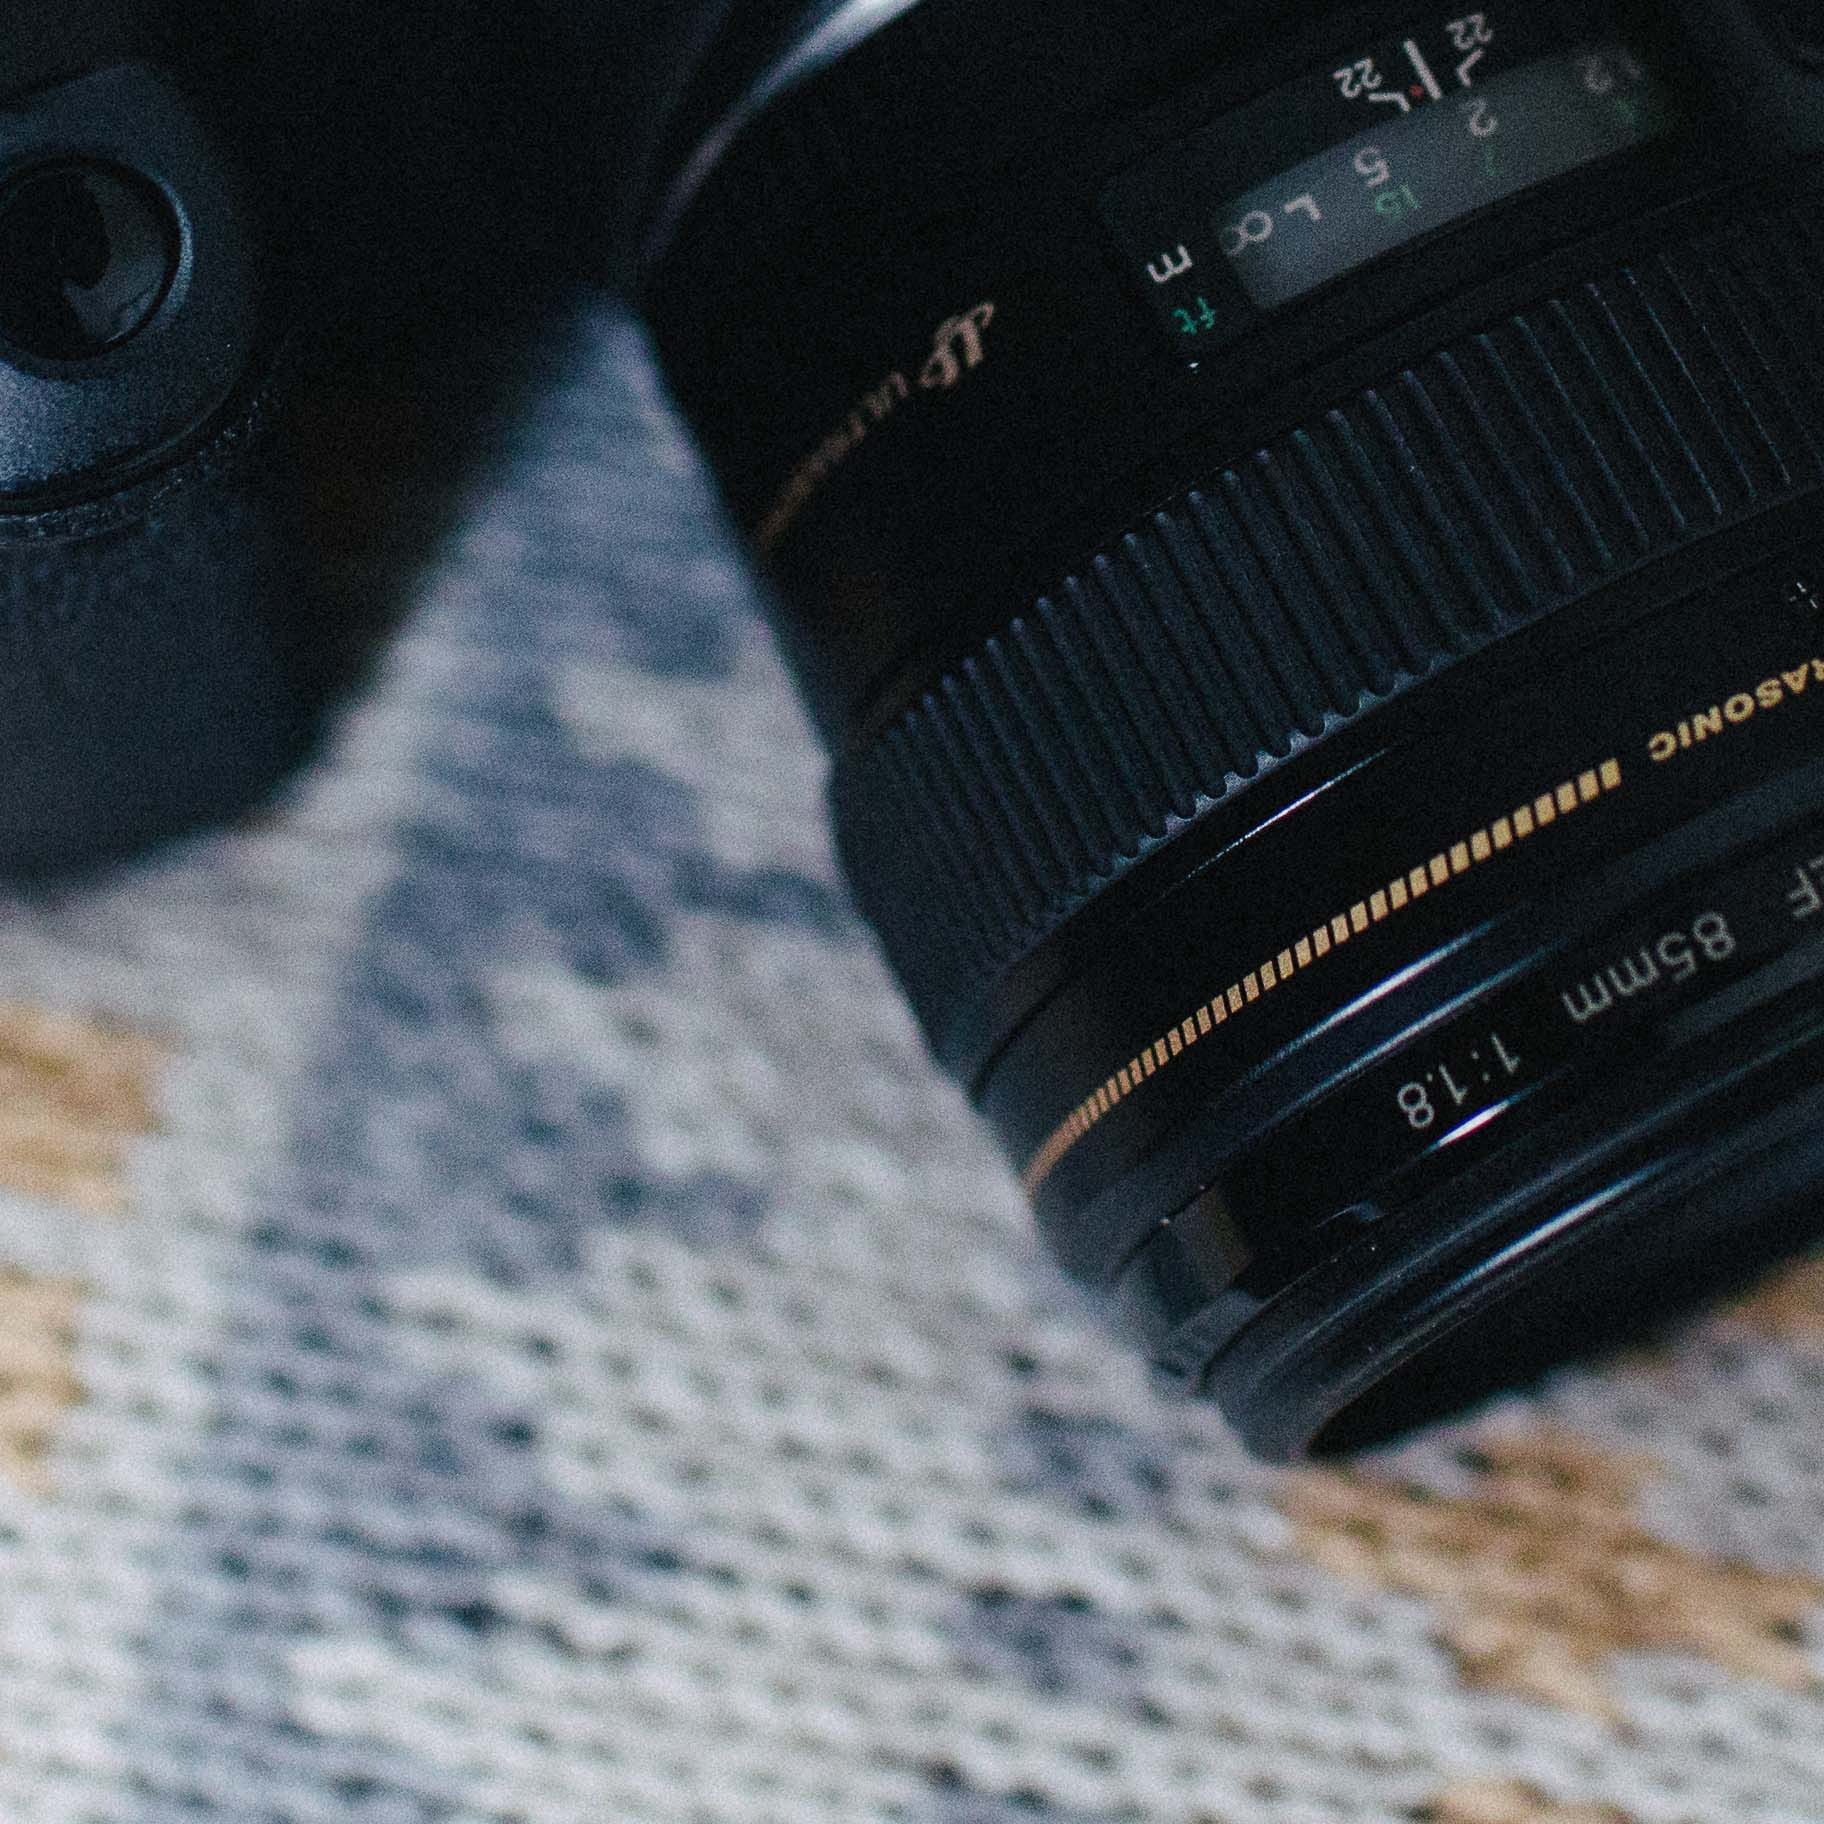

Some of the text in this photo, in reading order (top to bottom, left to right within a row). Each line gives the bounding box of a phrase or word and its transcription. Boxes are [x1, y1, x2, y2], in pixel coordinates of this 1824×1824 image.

[1333, 13, 1494, 100] 22 22
[1353, 145, 1390, 188] 5
[1146, 244, 1193, 284] m
[1561, 909, 1737, 1026] 85mm
[1395, 1029, 1523, 1132] 1:1.8
